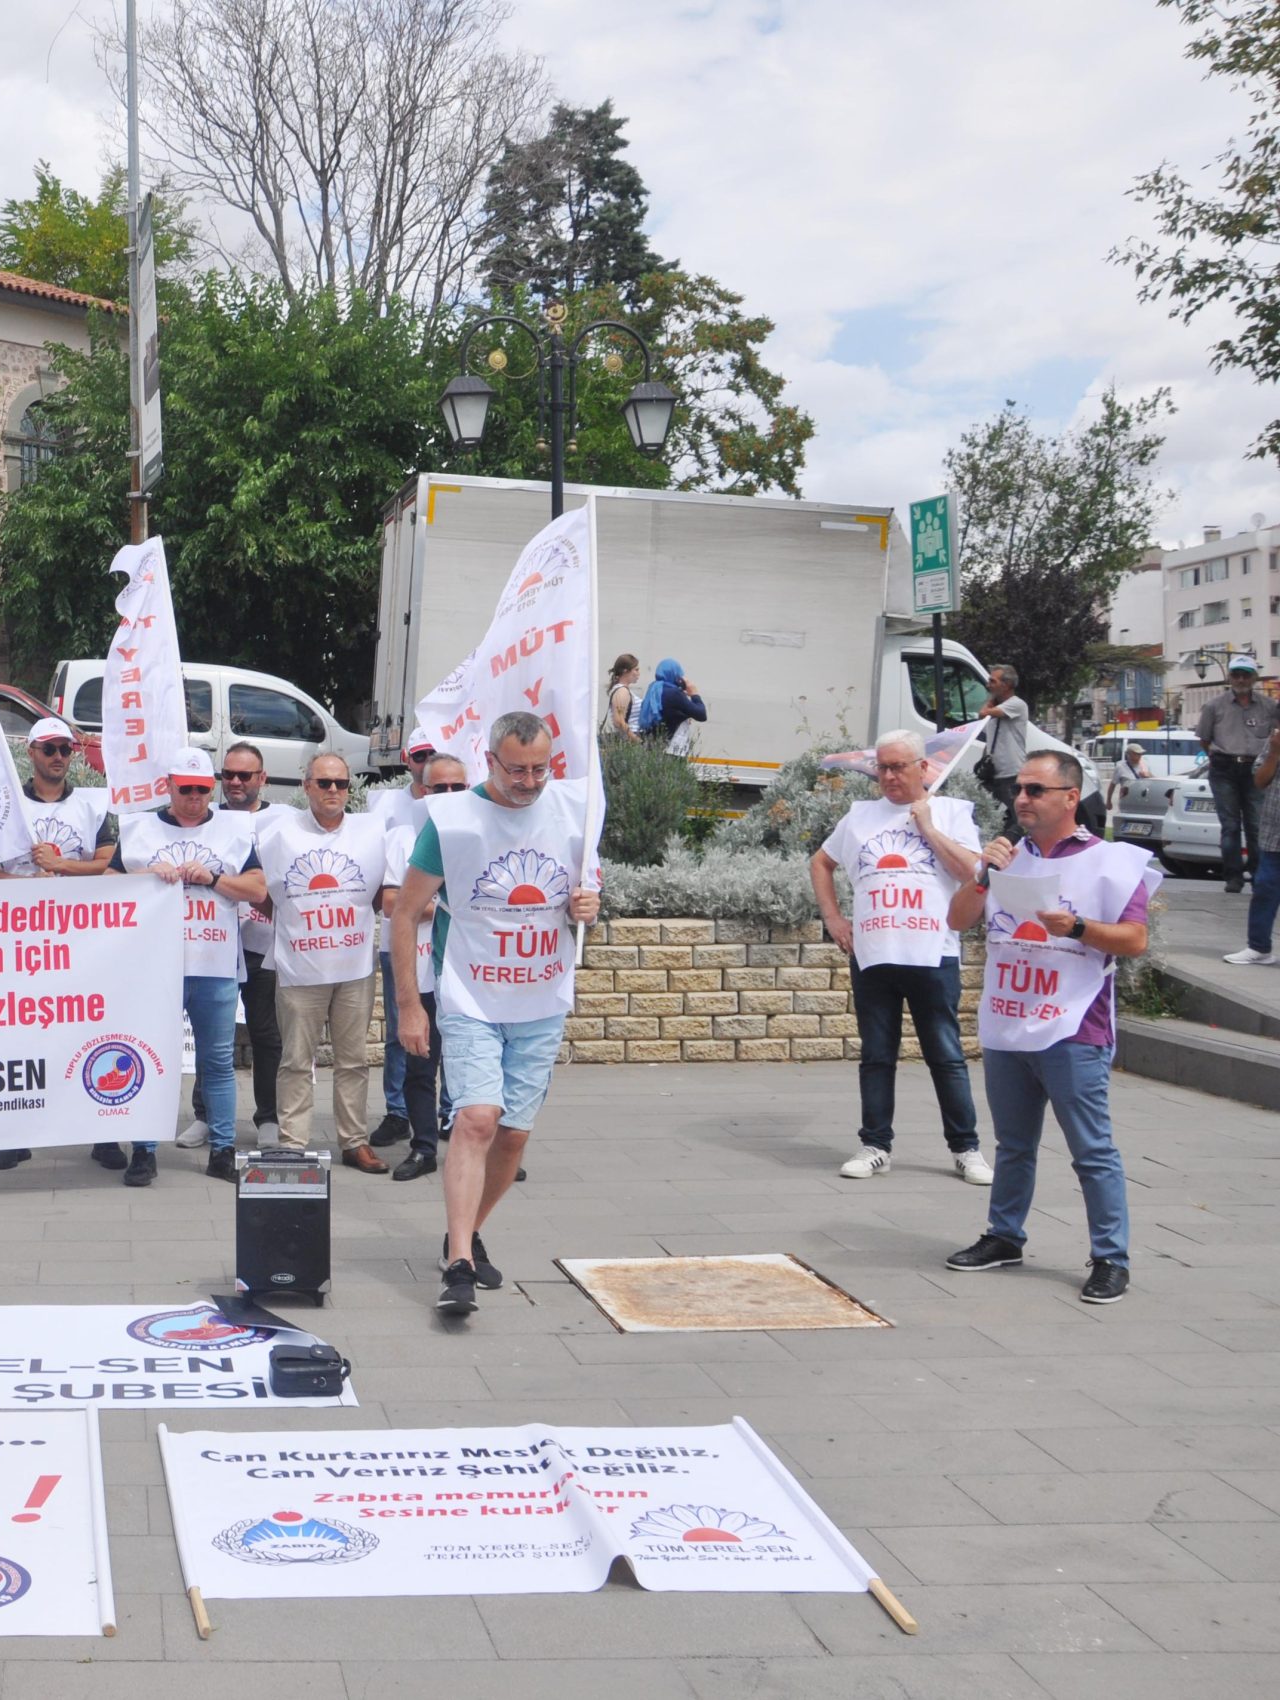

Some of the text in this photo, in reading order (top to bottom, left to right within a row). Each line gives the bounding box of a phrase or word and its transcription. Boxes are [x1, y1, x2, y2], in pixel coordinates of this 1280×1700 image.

[868, 884, 922, 911] TÜM
[300, 904, 355, 931] TÜM
[860, 916, 940, 933] YEREL-SEN
[290, 931, 365, 952] YEREL-SEN
[493, 925, 558, 958] TÜM
[15, 939, 70, 977] için
[469, 959, 563, 984] YEREL-SEN
[996, 960, 1058, 996] TÜM
[97, 1107, 130, 1117] OLMAZ
[14, 1377, 269, 1402] ŞUBESİ
[200, 1449, 267, 1463] Can
[279, 1451, 451, 1462] Kurtarırız
[586, 1446, 720, 1460] Değiliz,
[246, 1467, 315, 1479] Can
[324, 1465, 448, 1478] Veririz
[573, 1462, 690, 1477] eğiliz.
[11, 1475, 62, 1523] !
[313, 1492, 424, 1503] Zabıta
[358, 1506, 469, 1518] Sesine
